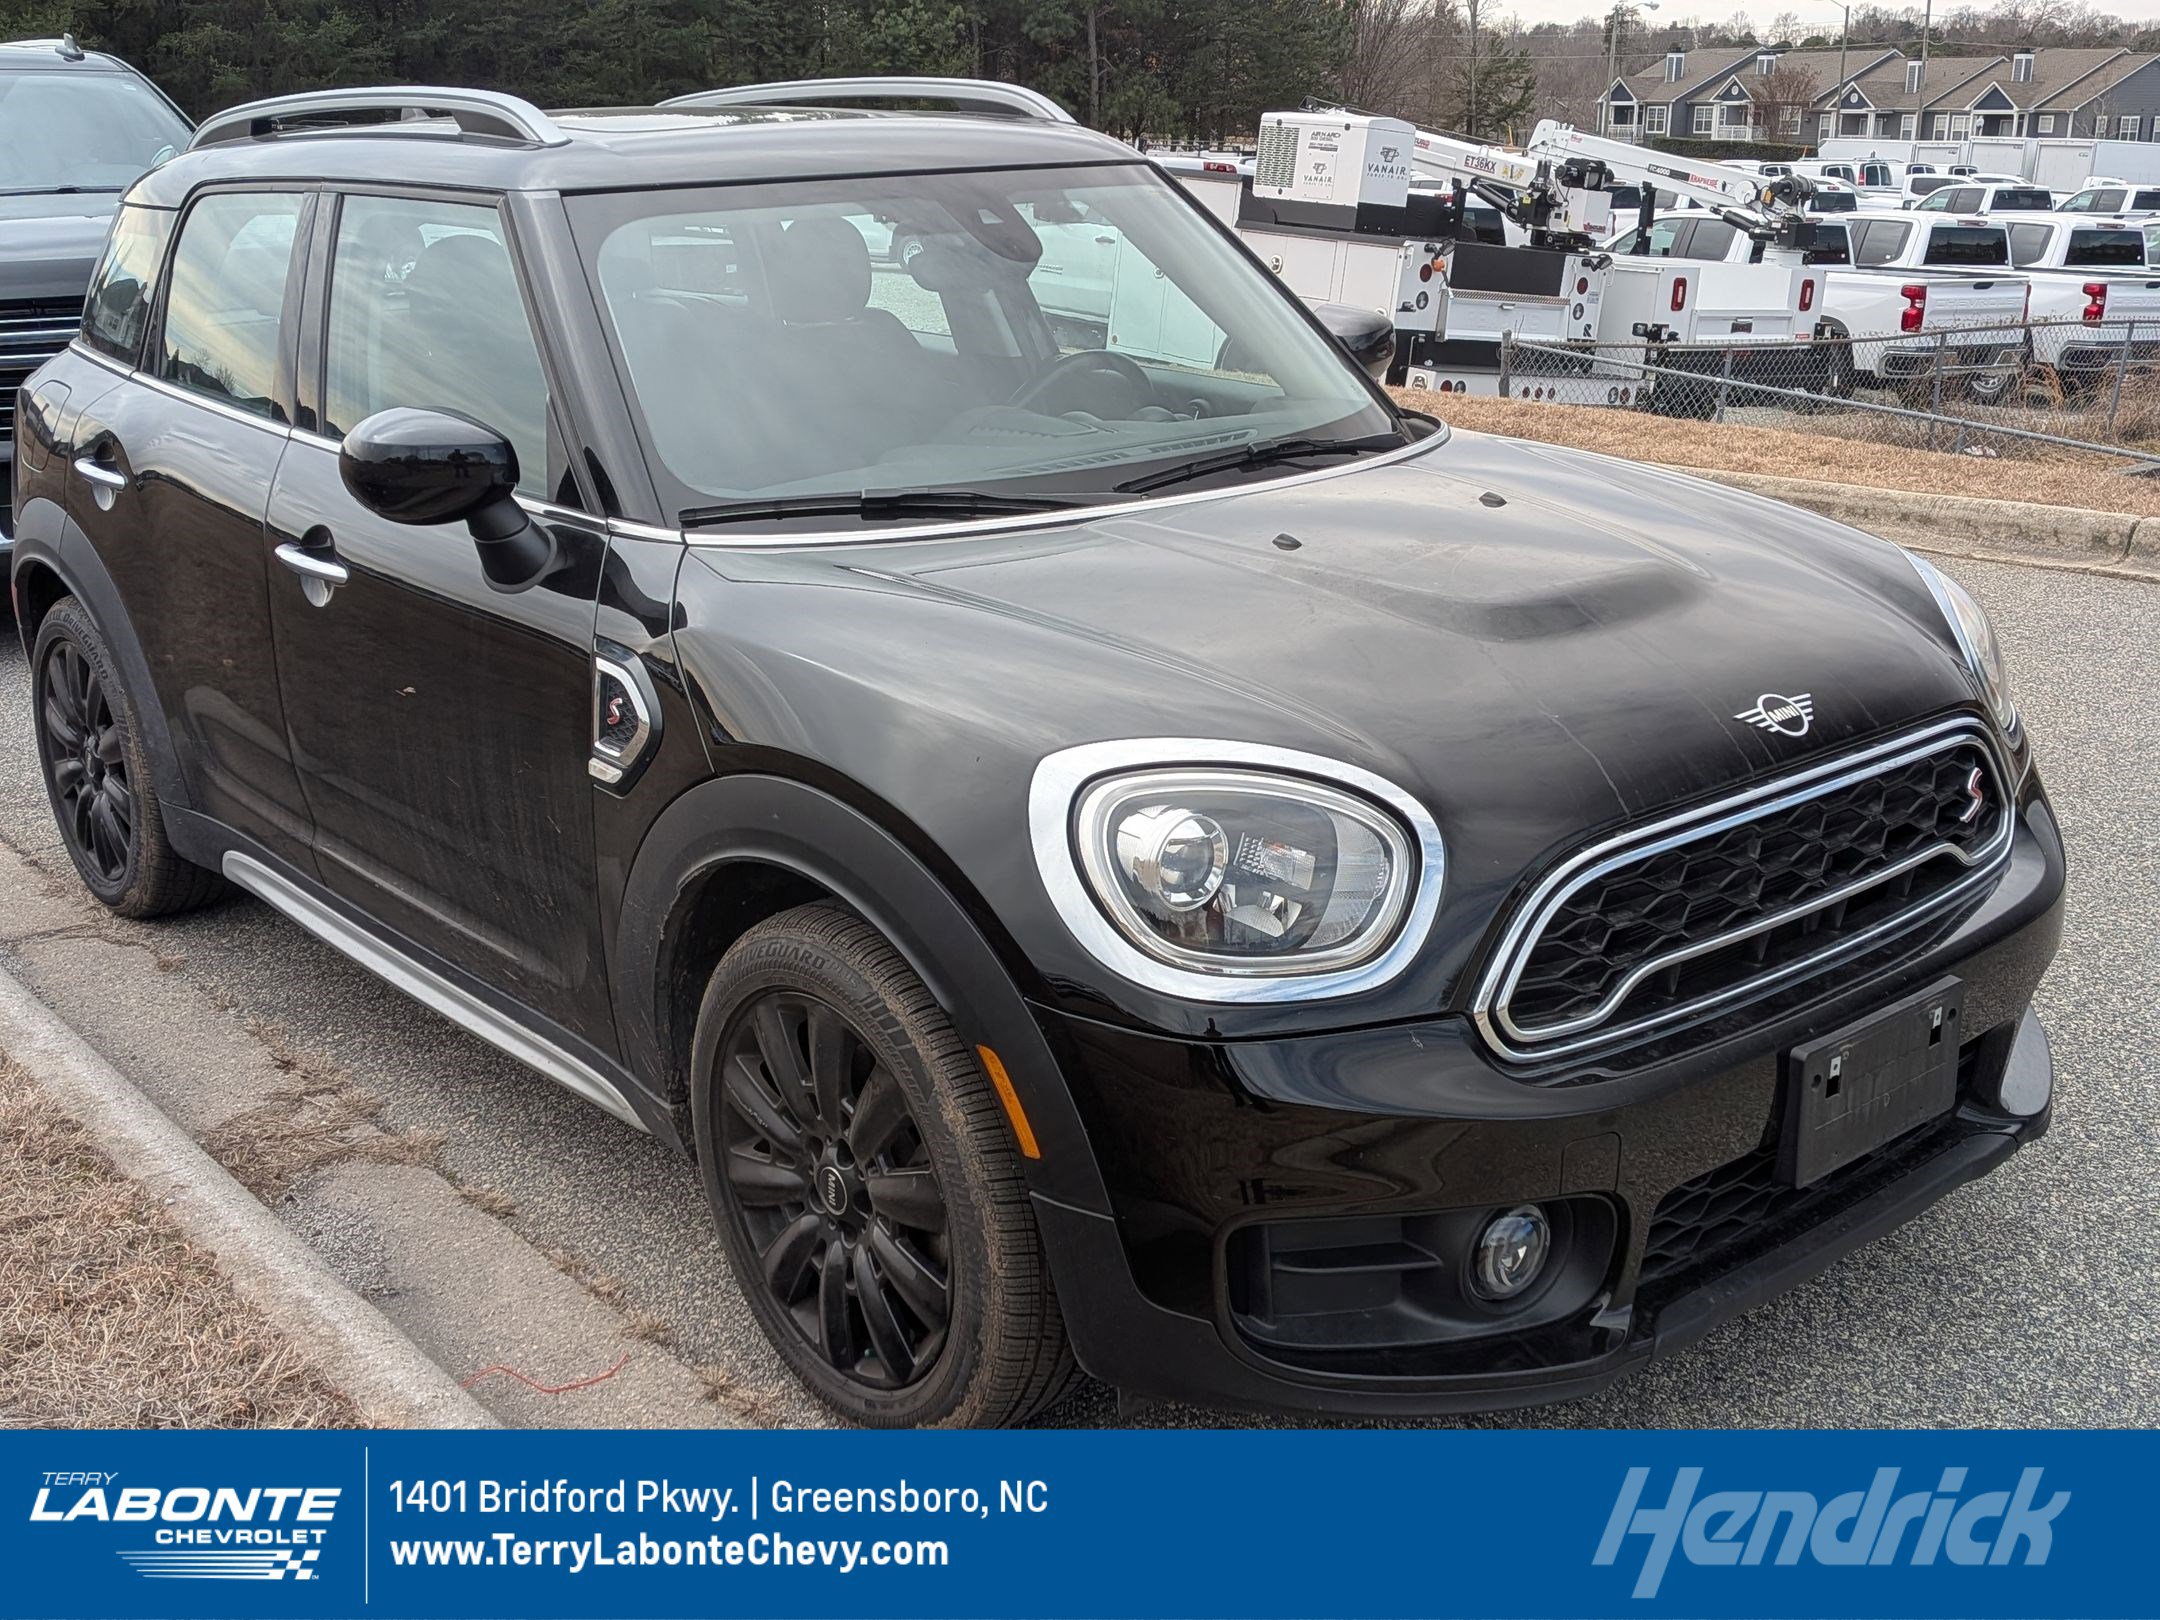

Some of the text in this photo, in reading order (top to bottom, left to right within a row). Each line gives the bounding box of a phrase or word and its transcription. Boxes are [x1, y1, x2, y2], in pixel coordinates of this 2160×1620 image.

[1368, 162, 1406, 176] VANAIR
[1464, 155, 1497, 172] ET36KX
[1303, 174, 1332, 184] VANAIR
[62, 613, 109, 680] DRIVEGUARD
[607, 697, 623, 725] S
[1767, 704, 1801, 724] MINI
[1959, 766, 1983, 823] S
[827, 1172, 837, 1207] MINI
